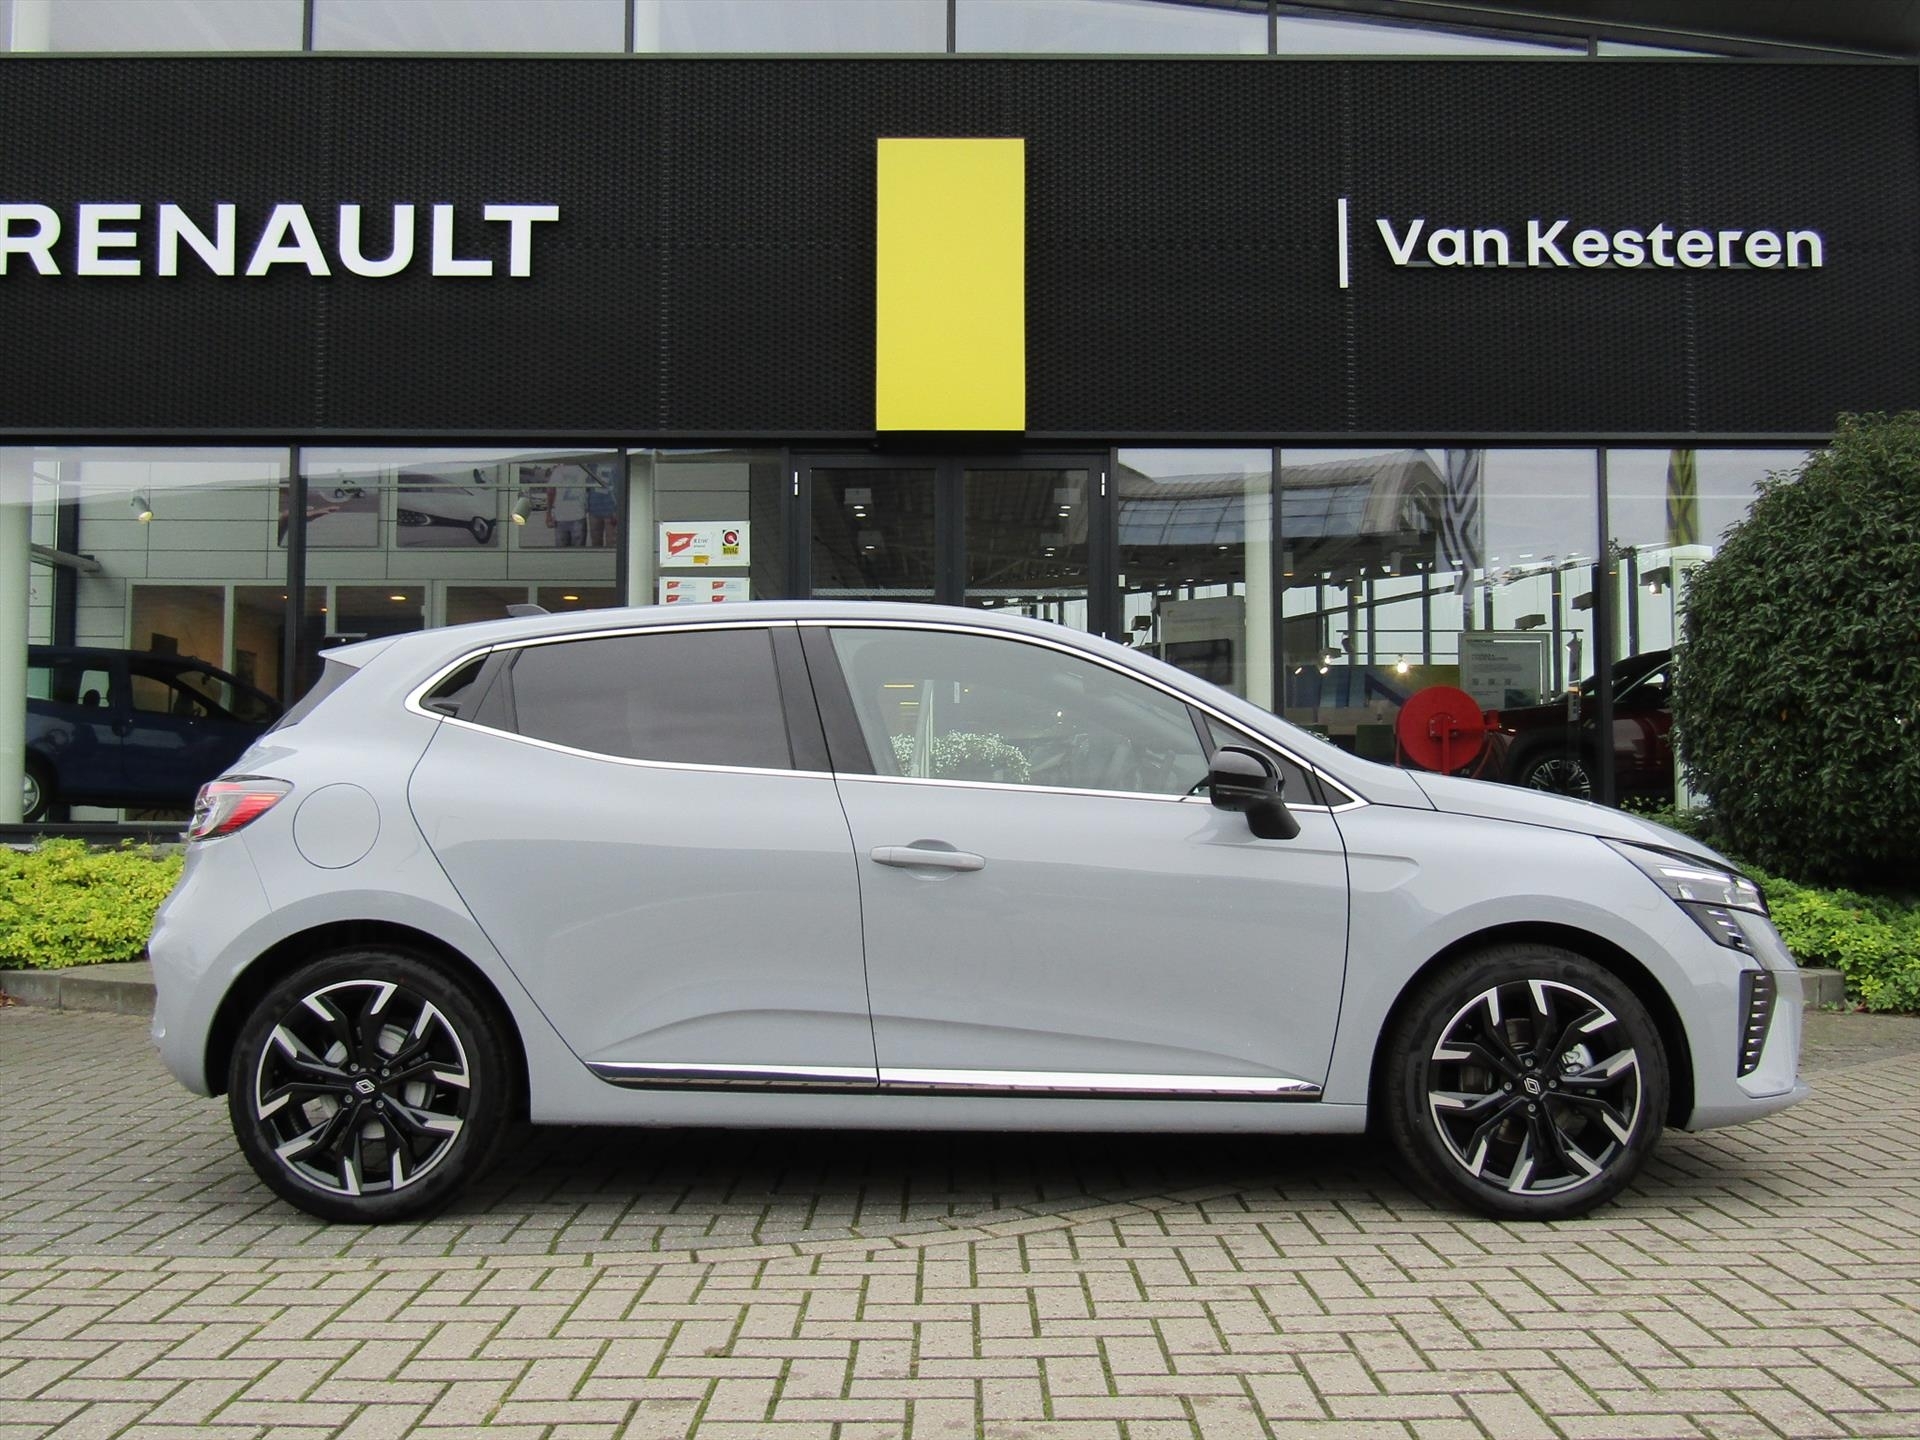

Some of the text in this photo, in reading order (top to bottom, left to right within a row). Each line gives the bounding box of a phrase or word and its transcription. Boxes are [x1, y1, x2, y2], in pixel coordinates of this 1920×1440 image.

[0, 204, 559, 277] RENAULT
[1376, 219, 1823, 267] Van Kesteren
